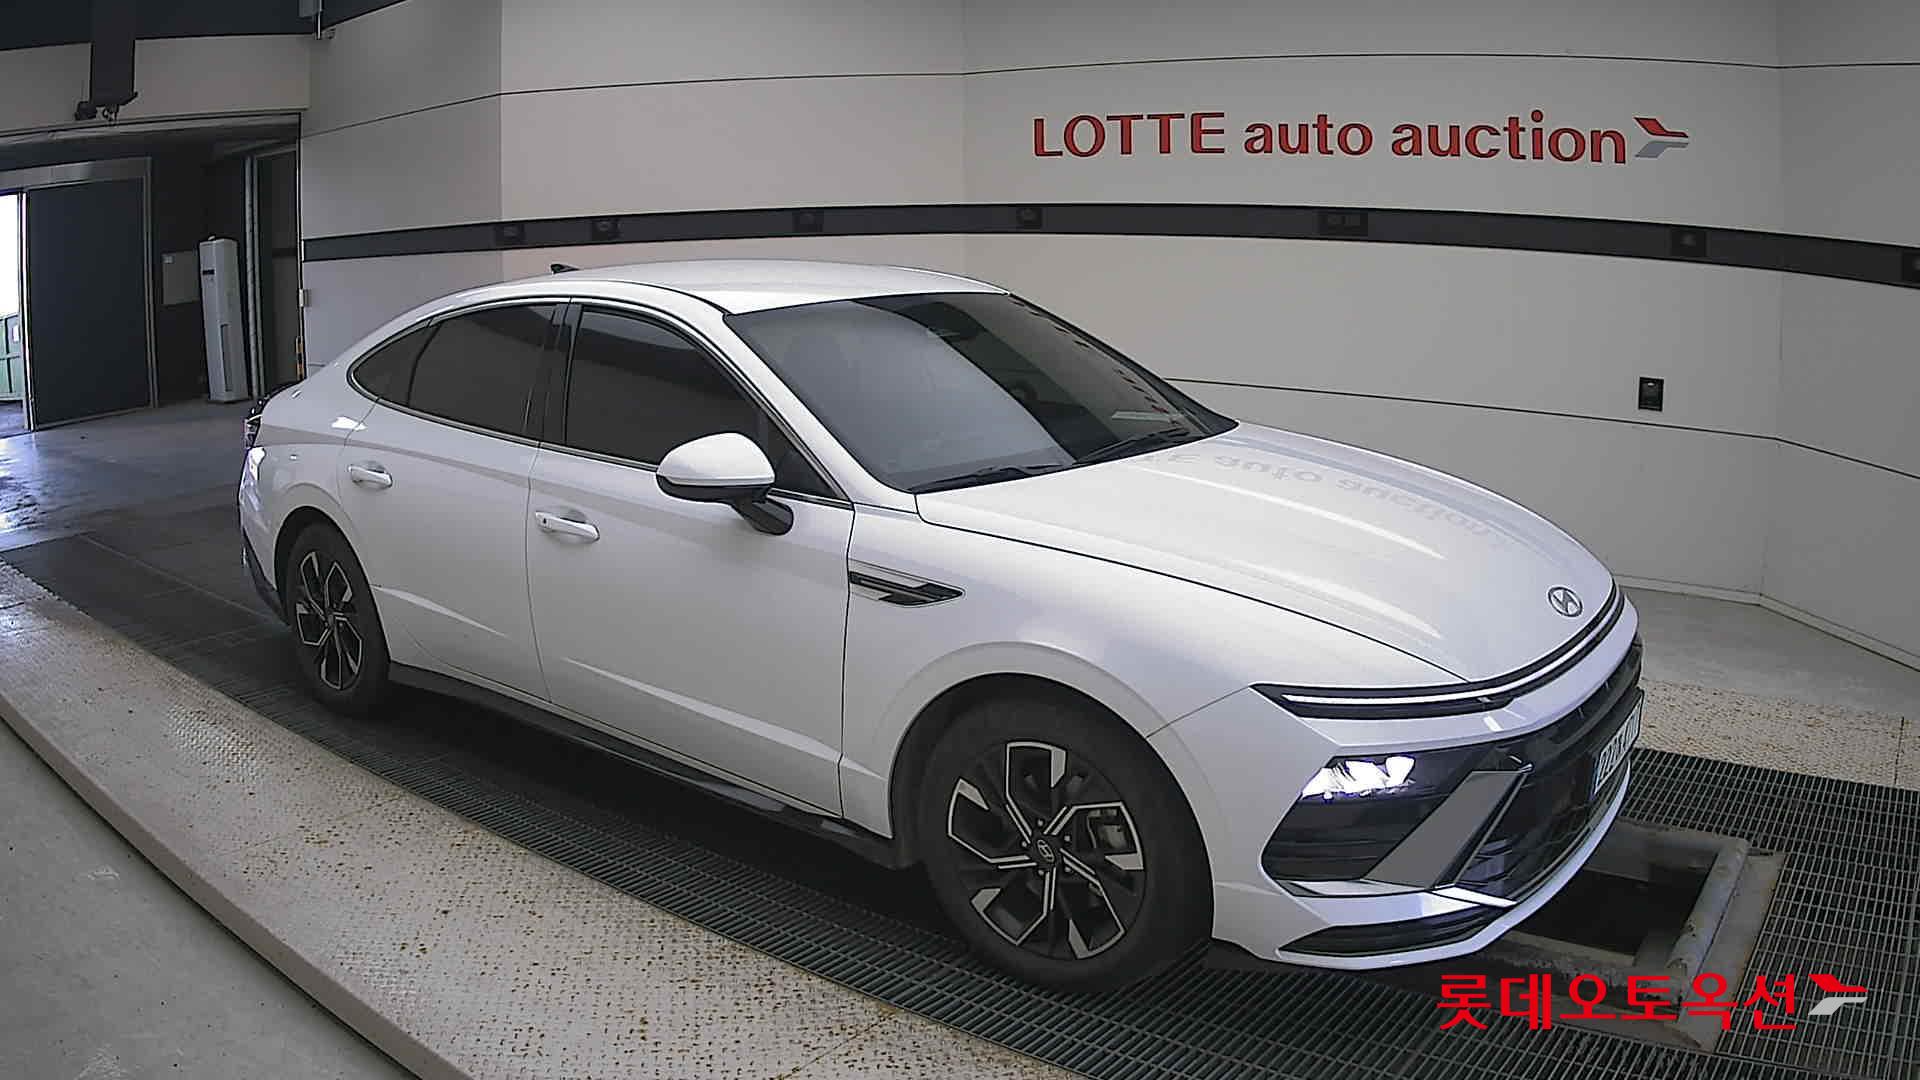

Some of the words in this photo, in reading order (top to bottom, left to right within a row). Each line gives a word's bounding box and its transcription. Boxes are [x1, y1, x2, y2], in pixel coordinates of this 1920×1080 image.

[1033, 111, 1226, 157] LOTTE
[1243, 112, 1374, 156] auto
[1390, 108, 1628, 164] auction
